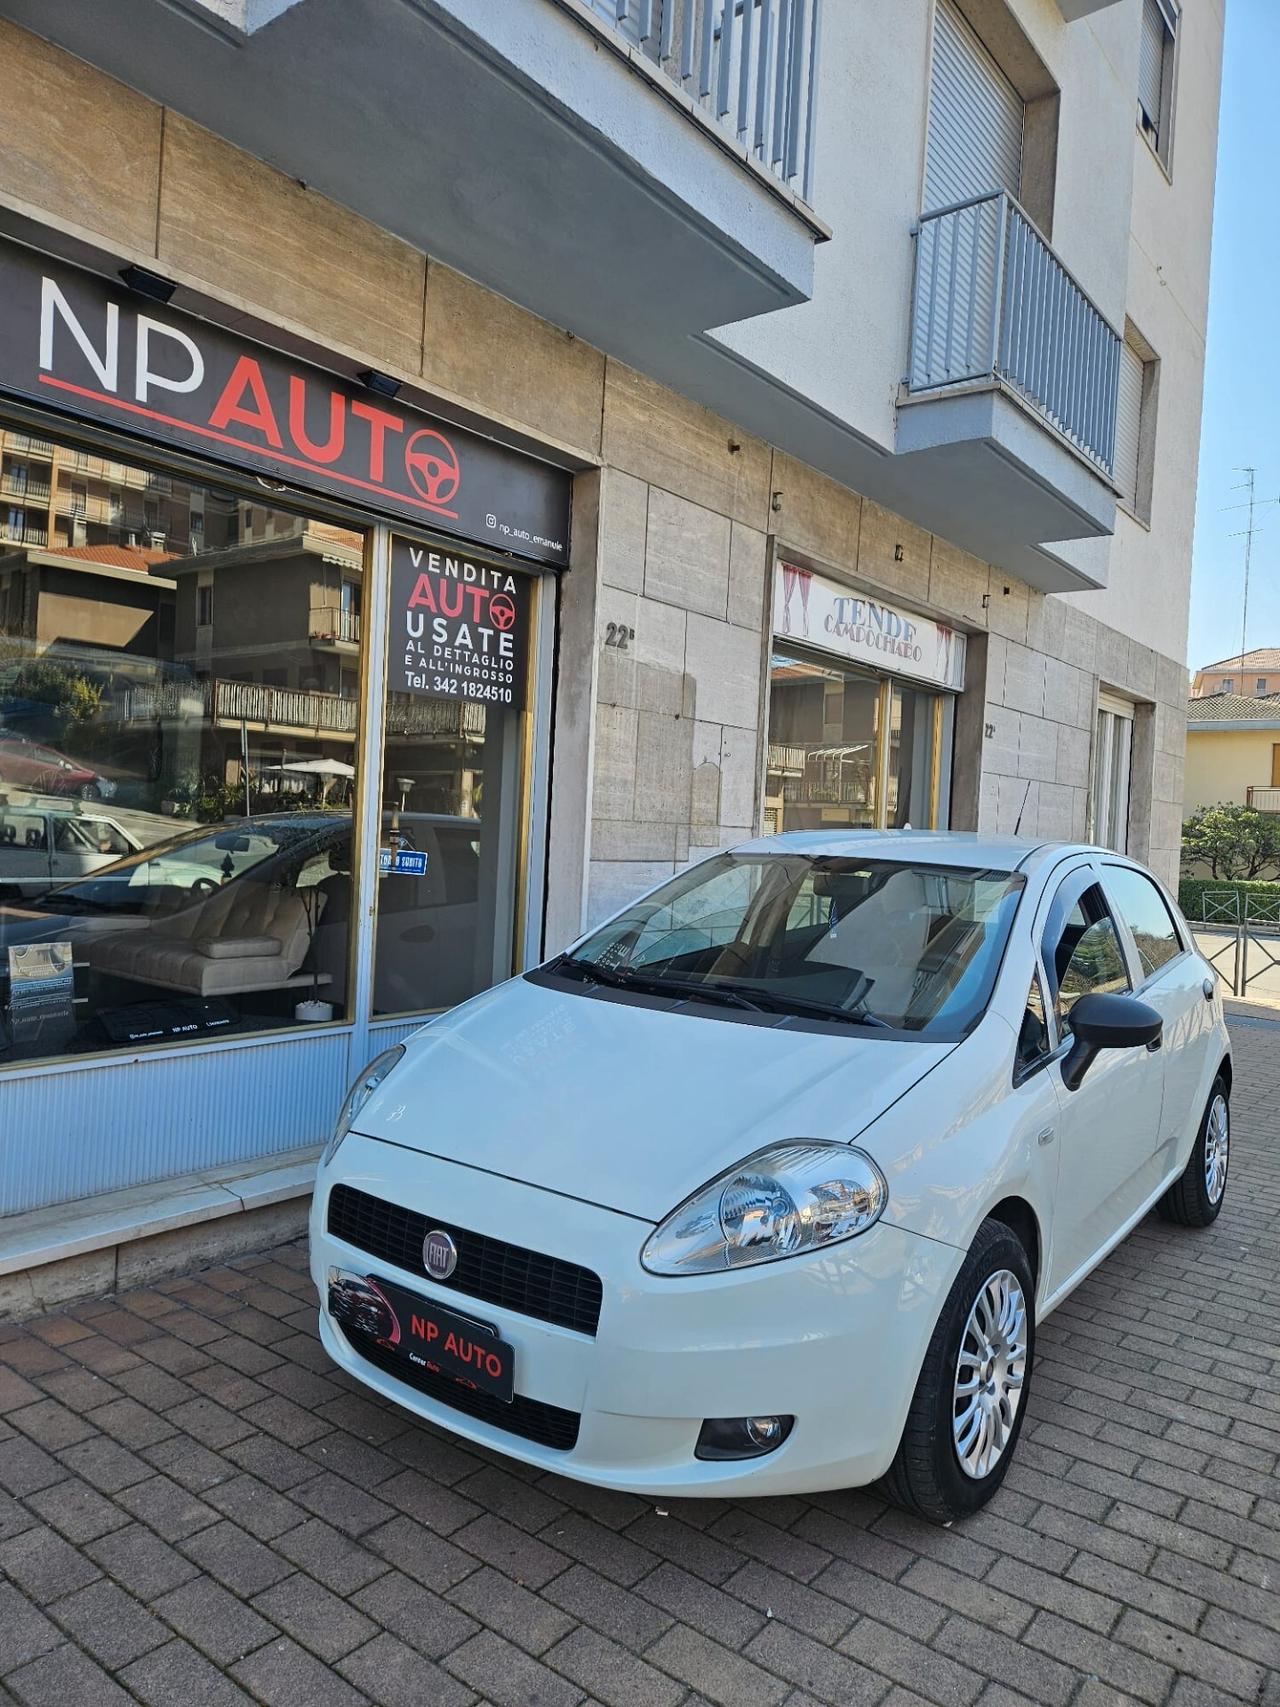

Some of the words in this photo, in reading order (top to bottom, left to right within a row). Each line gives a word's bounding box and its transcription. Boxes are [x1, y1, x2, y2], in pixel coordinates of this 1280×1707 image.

[409, 547, 517, 594] VENDITA
[405, 610, 514, 658] USATE
[405, 654, 412, 665] E
[419, 656, 513, 684] ALL'INGROSSO
[406, 639, 426, 654] AL
[433, 644, 514, 671] DETTAGLIO
[405, 670, 429, 690] Tel.
[433, 676, 458, 695] 342
[461, 680, 512, 704] 1824510
[428, 1243, 449, 1269] FIAT
[410, 1313, 439, 1343] NP
[444, 1332, 502, 1378] AUTO
